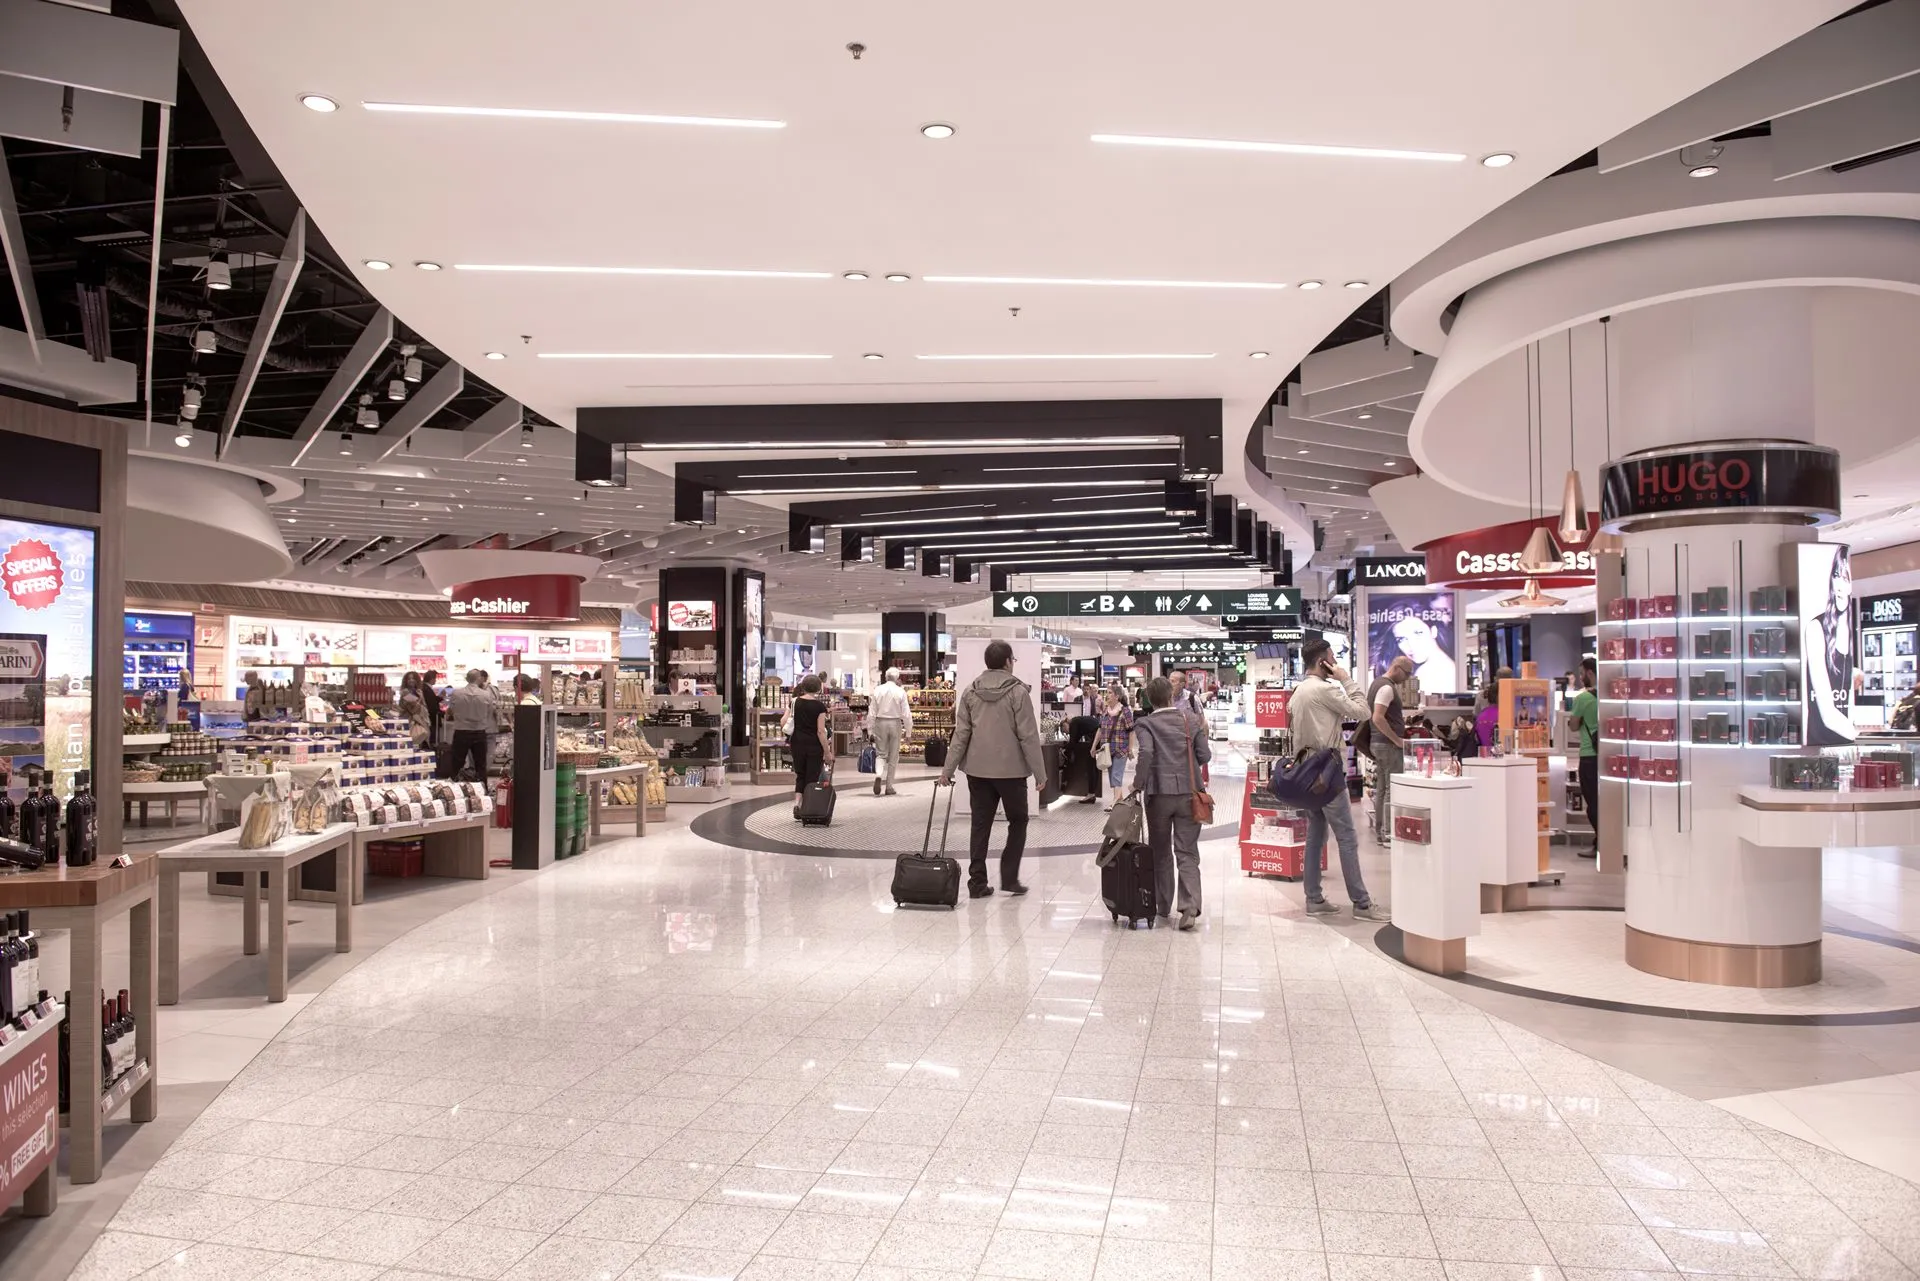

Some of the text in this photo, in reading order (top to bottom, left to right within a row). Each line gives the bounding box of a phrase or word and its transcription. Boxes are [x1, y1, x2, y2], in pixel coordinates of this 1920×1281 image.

[1637, 458, 1751, 496] HUGO
[1638, 490, 1749, 505] HUGO BOSS
[6, 555, 57, 577] SPECIAL
[12, 575, 58, 596] OFFERS
[1100, 595, 1114, 612] B
[1874, 598, 1902, 616] BOSS
[1810, 689, 1848, 702] HGO
[1251, 847, 1284, 861] SPECIAL
[1252, 860, 1283, 873] OFFERS
[3, 1052, 48, 1115] WINES
[2, 1089, 49, 1143] this selection
[12, 1129, 46, 1174] FREE GIFT
